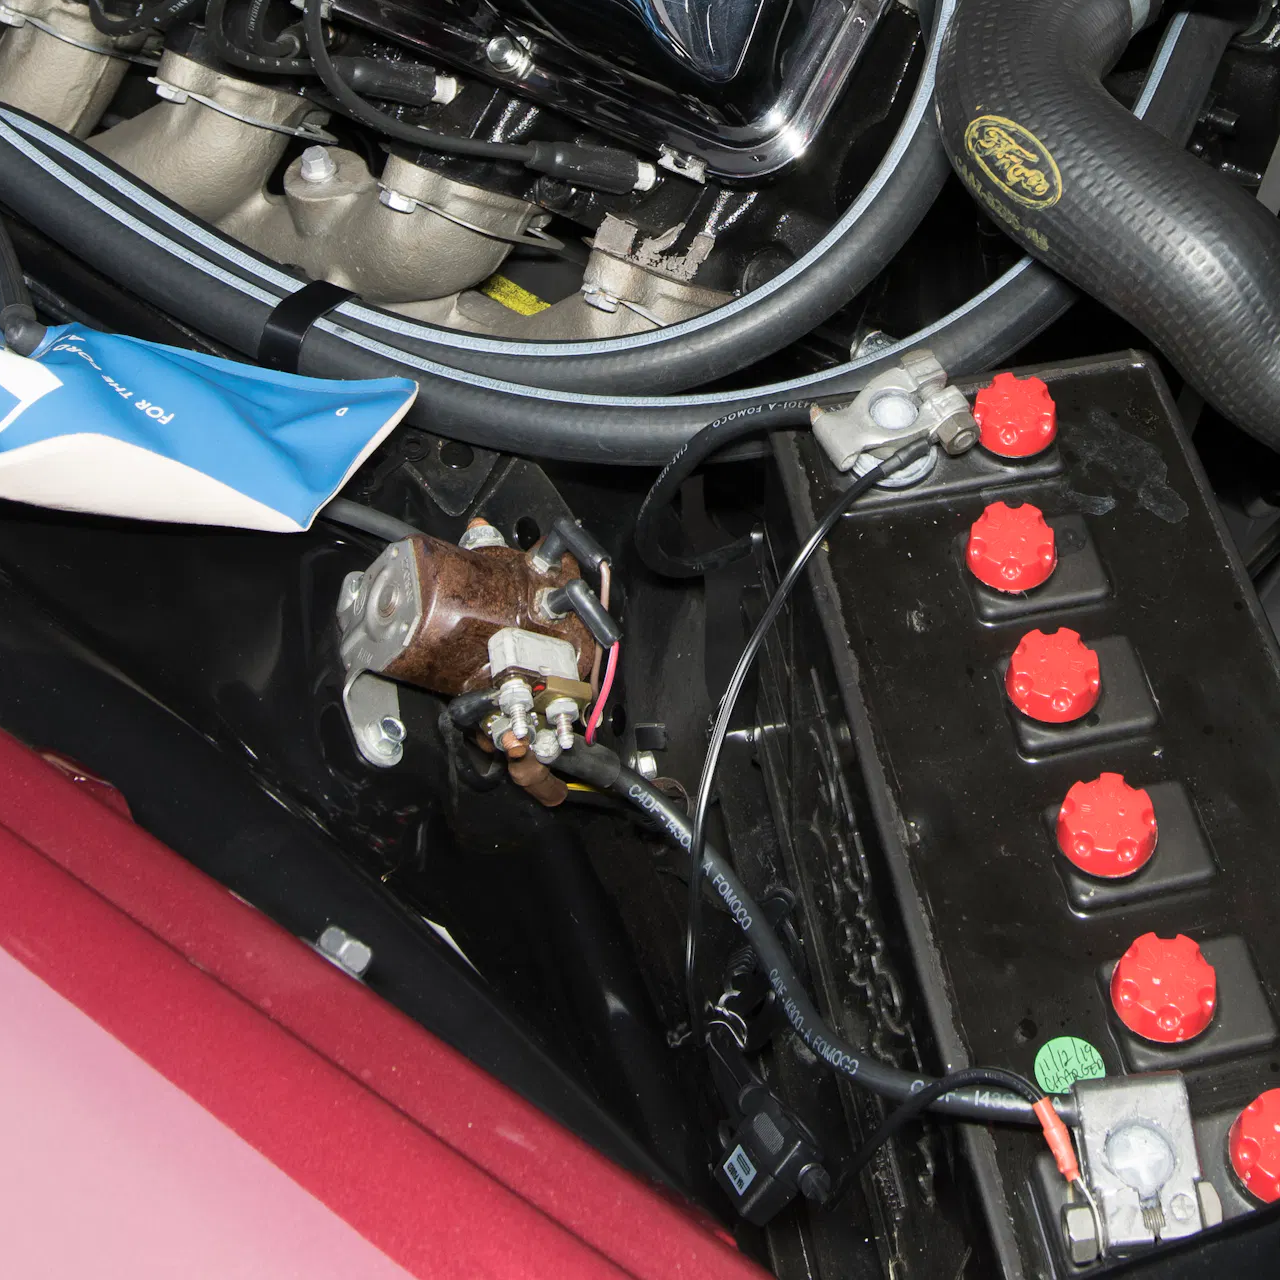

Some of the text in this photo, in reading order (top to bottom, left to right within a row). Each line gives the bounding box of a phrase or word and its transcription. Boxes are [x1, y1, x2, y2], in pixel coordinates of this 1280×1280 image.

[134, 399, 175, 425] FOR
[713, 403, 762, 429] FOMOCO
[712, 872, 753, 931] FOMOCO
[811, 1035, 860, 1076] FOMOCO
